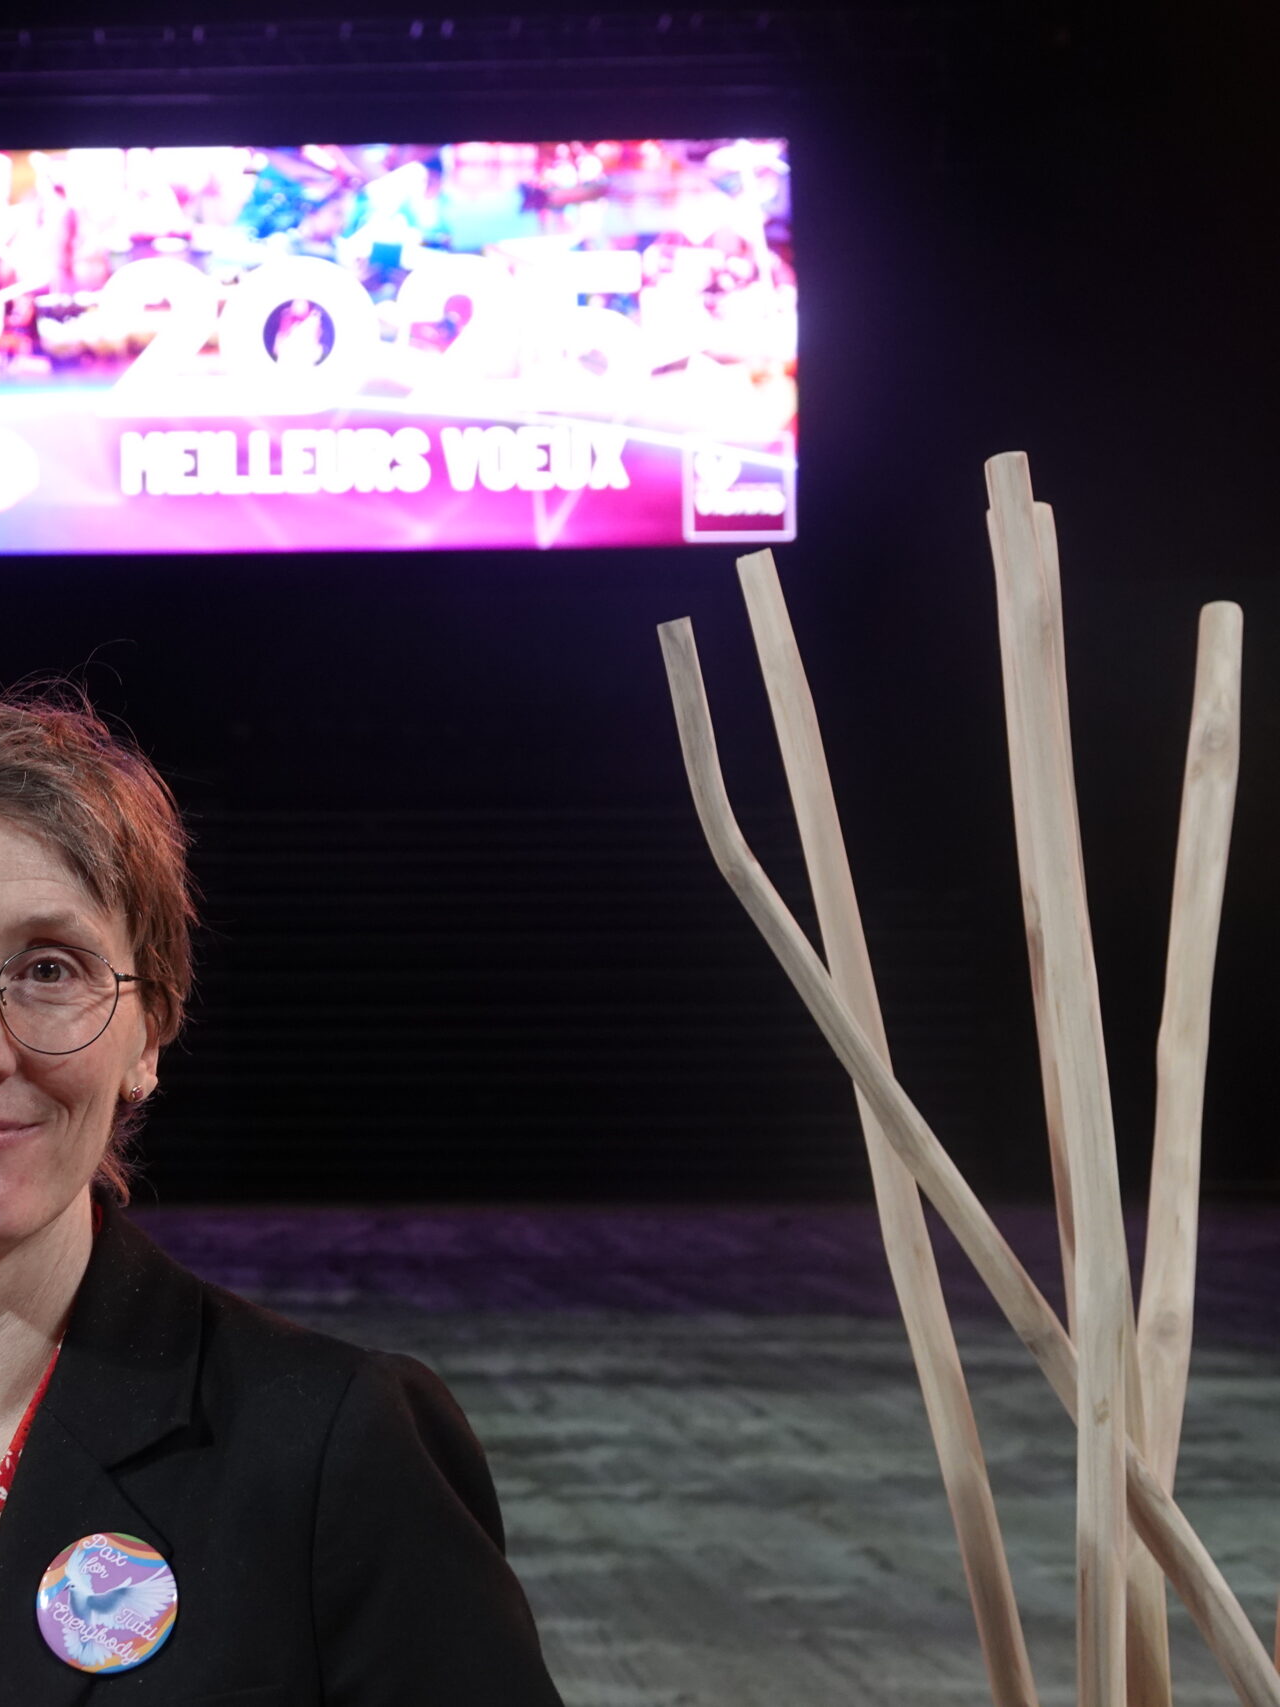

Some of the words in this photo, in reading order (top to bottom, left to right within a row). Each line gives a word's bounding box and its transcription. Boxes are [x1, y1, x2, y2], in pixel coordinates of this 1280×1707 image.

[100, 254, 646, 412] 2025
[121, 428, 431, 494] MEILLEURS
[441, 425, 630, 490] VOEUX
[81, 1557, 109, 1579] for
[83, 1533, 128, 1567] Pax
[52, 1602, 140, 1665] Everybody
